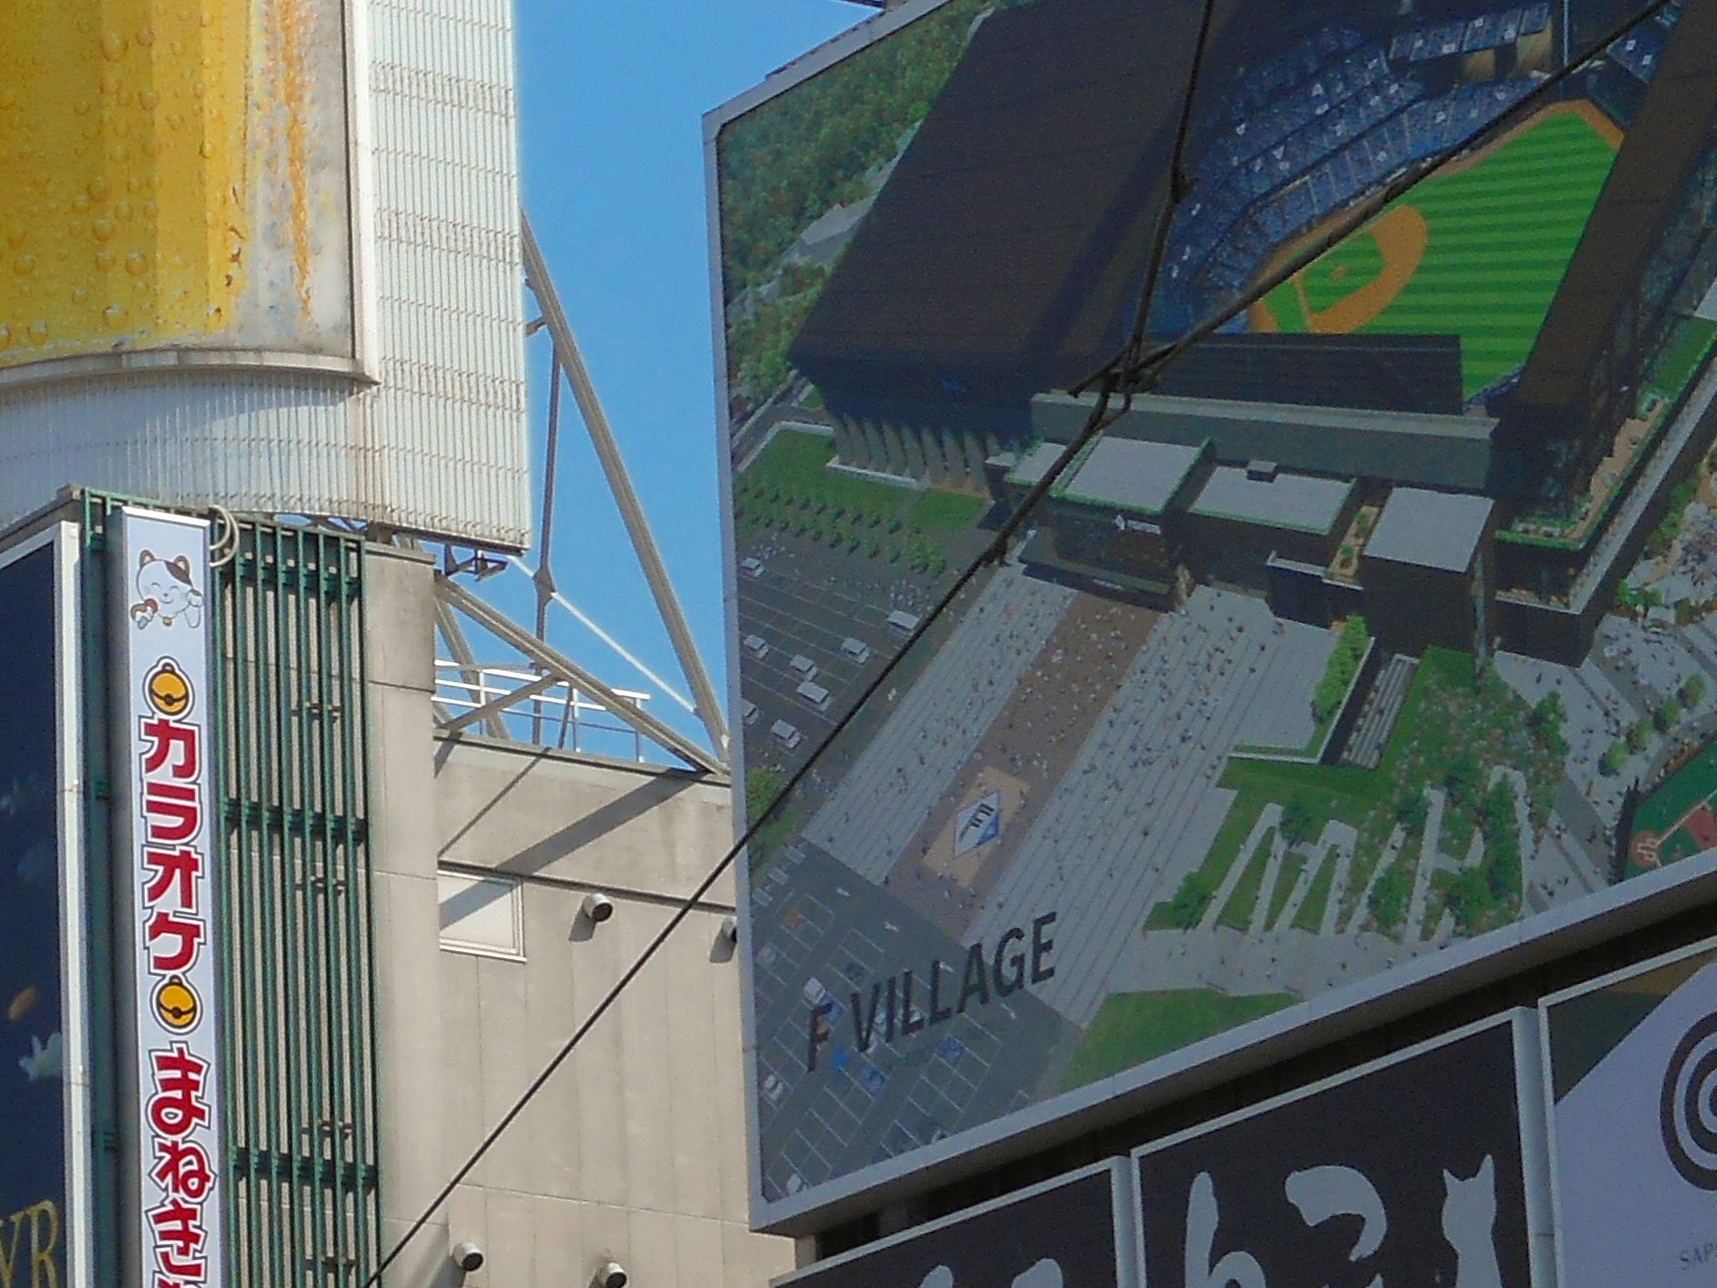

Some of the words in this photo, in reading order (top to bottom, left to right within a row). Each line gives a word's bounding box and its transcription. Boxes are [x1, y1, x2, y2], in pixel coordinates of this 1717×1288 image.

[142, 717, 202, 974] カラオケ
[807, 1003, 833, 1074] F
[850, 911, 1057, 1053] VILLAGE
